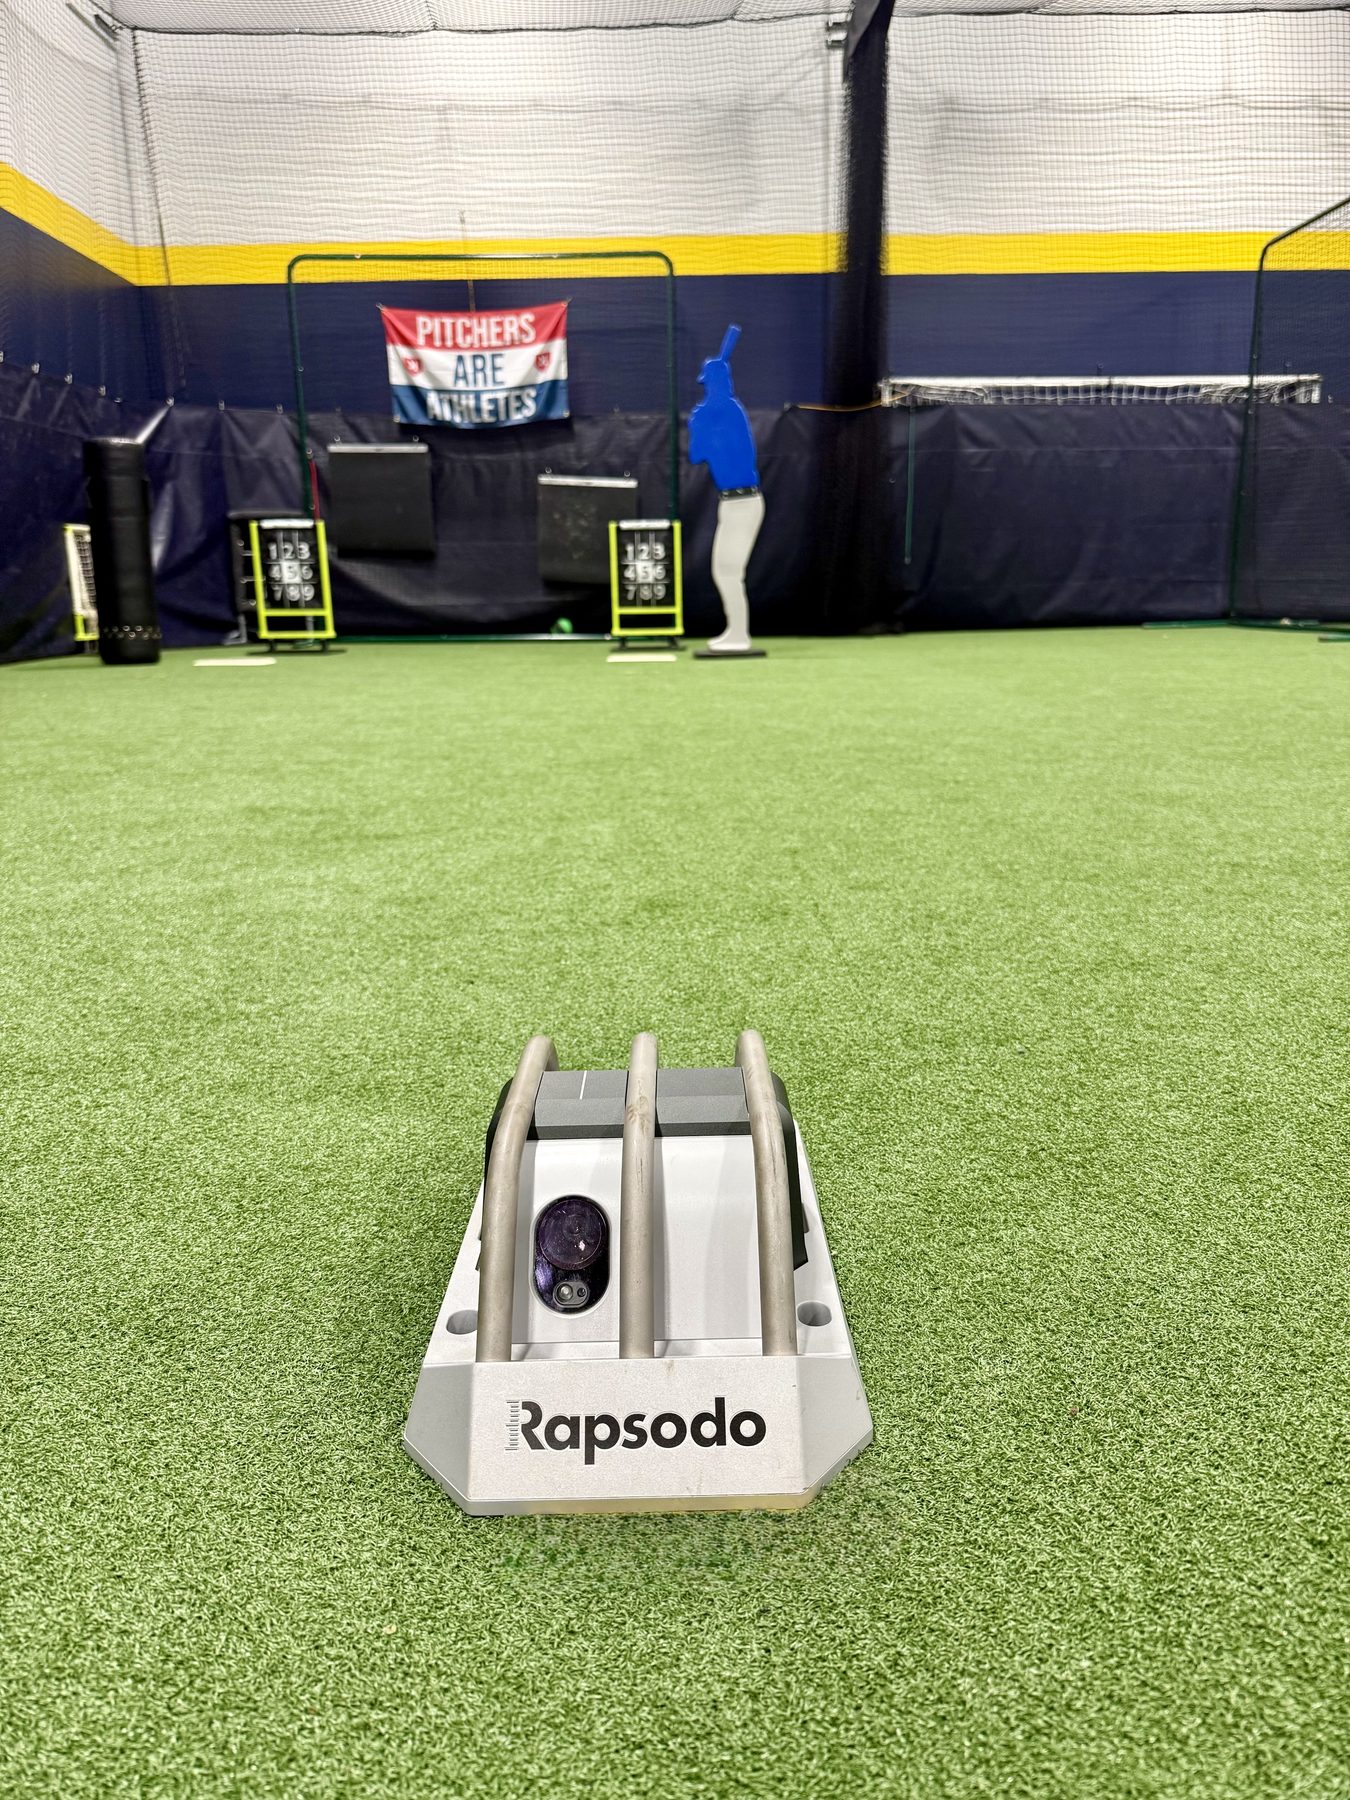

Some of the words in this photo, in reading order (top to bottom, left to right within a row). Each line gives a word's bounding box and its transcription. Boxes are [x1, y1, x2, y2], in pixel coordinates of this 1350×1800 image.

[417, 313, 536, 348] PITCHERS
[454, 353, 505, 387] ARE
[426, 388, 537, 423] ATHLETES
[505, 1397, 767, 1465] Rapsodo
